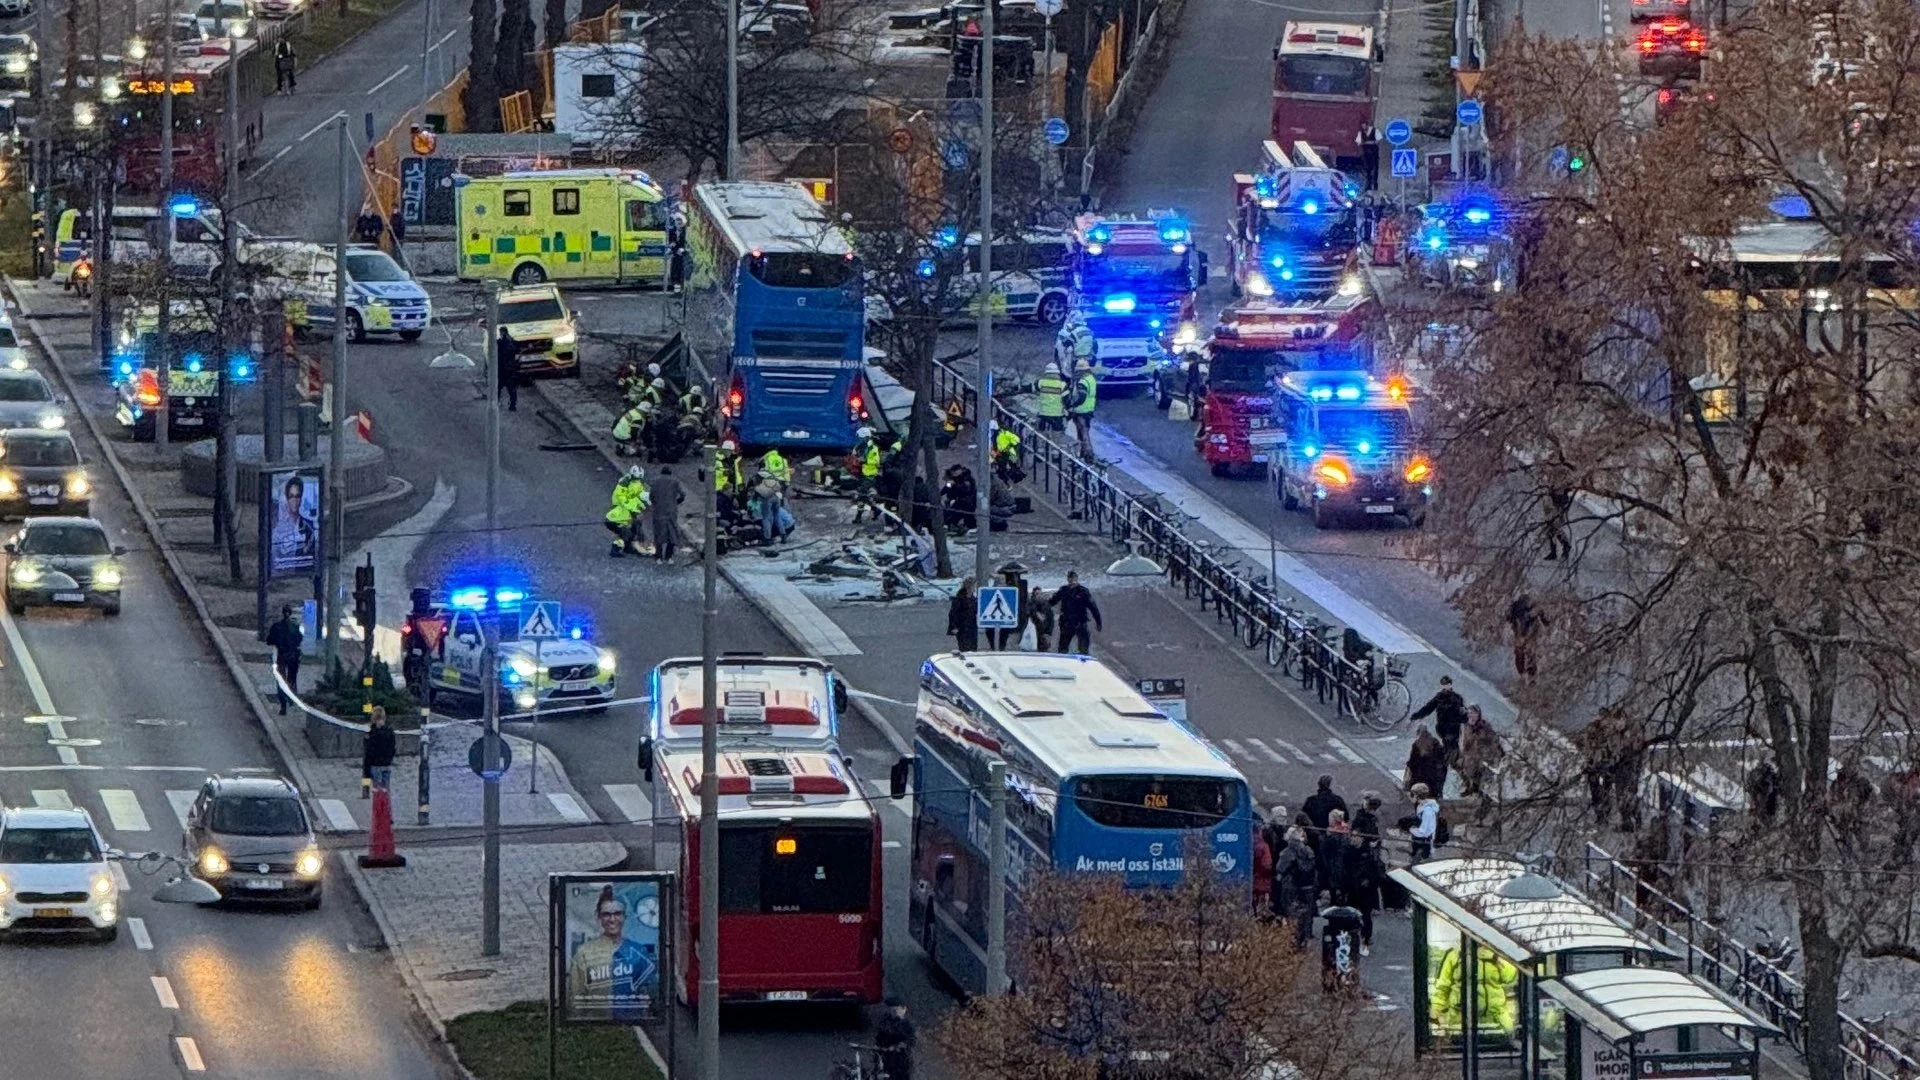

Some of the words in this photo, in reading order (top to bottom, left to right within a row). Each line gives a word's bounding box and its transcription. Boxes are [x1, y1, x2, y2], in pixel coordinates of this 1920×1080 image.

[1076, 855, 1094, 871] Åk
[1097, 858, 1126, 871] med
[1128, 860, 1150, 871] oss
[1152, 857, 1184, 871] iställ
[839, 914, 862, 923] 5000
[589, 966, 610, 980] till
[613, 963, 634, 976] du
[1643, 1060, 1653, 1074] G
